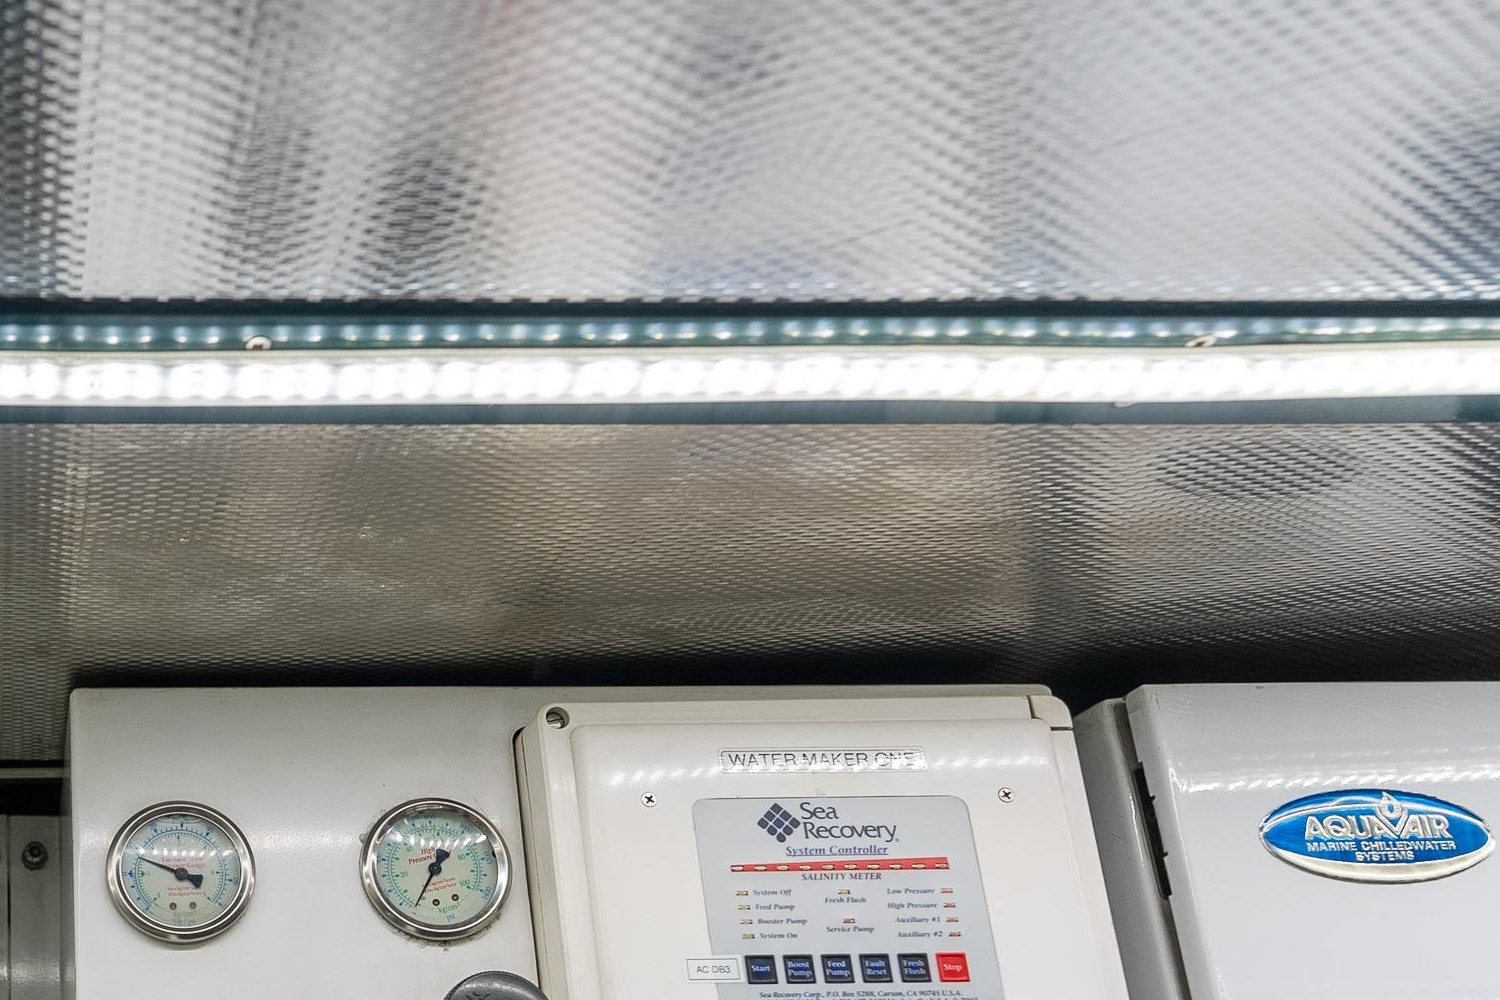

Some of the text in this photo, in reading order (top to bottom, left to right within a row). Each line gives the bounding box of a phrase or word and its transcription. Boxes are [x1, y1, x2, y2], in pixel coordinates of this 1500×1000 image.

[729, 753, 797, 768] WATER
[802, 752, 869, 767] MAKER
[800, 802, 839, 820] Sea
[803, 822, 897, 842] Recovery
[786, 845, 889, 856] System Controller
[1306, 842, 1357, 852] MARINE
[1355, 850, 1415, 861] SYSTEMS
[801, 872, 882, 881] SALINITY METER
[824, 896, 867, 904] Fresh Flush
[774, 904, 796, 912] Pump
[758, 918, 808, 926] Booster Pump
[826, 926, 875, 934] Service Pump
[751, 964, 771, 972] Start
[788, 960, 810, 968] Boost
[828, 960, 846, 968] Feed
[942, 963, 962, 972] Stop
[696, 966, 732, 974] AC DB3
[788, 969, 812, 978] Pump
[826, 969, 850, 977] Pump
[866, 968, 888, 976] Reset
